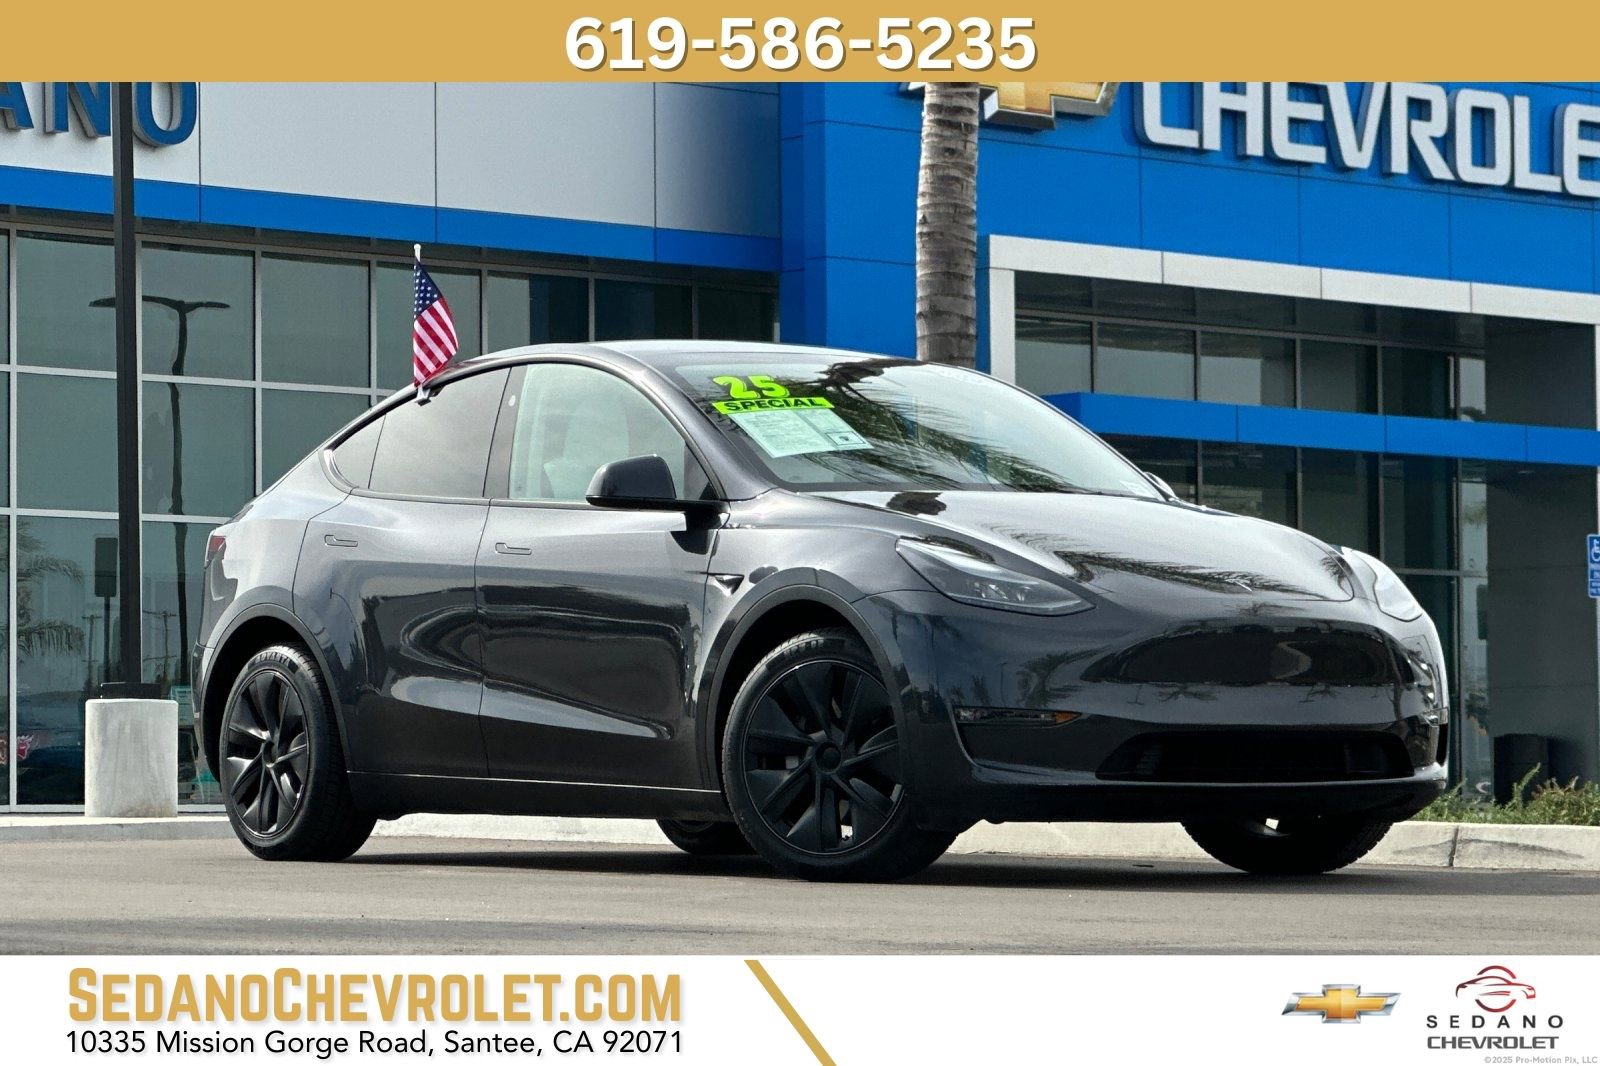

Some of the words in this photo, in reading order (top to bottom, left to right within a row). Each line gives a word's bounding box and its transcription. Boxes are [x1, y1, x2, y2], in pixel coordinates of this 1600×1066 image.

[1136, 82, 1600, 198] CHEVROLE
[713, 375, 790, 399] 25
[724, 398, 824, 412] SPECIAL
